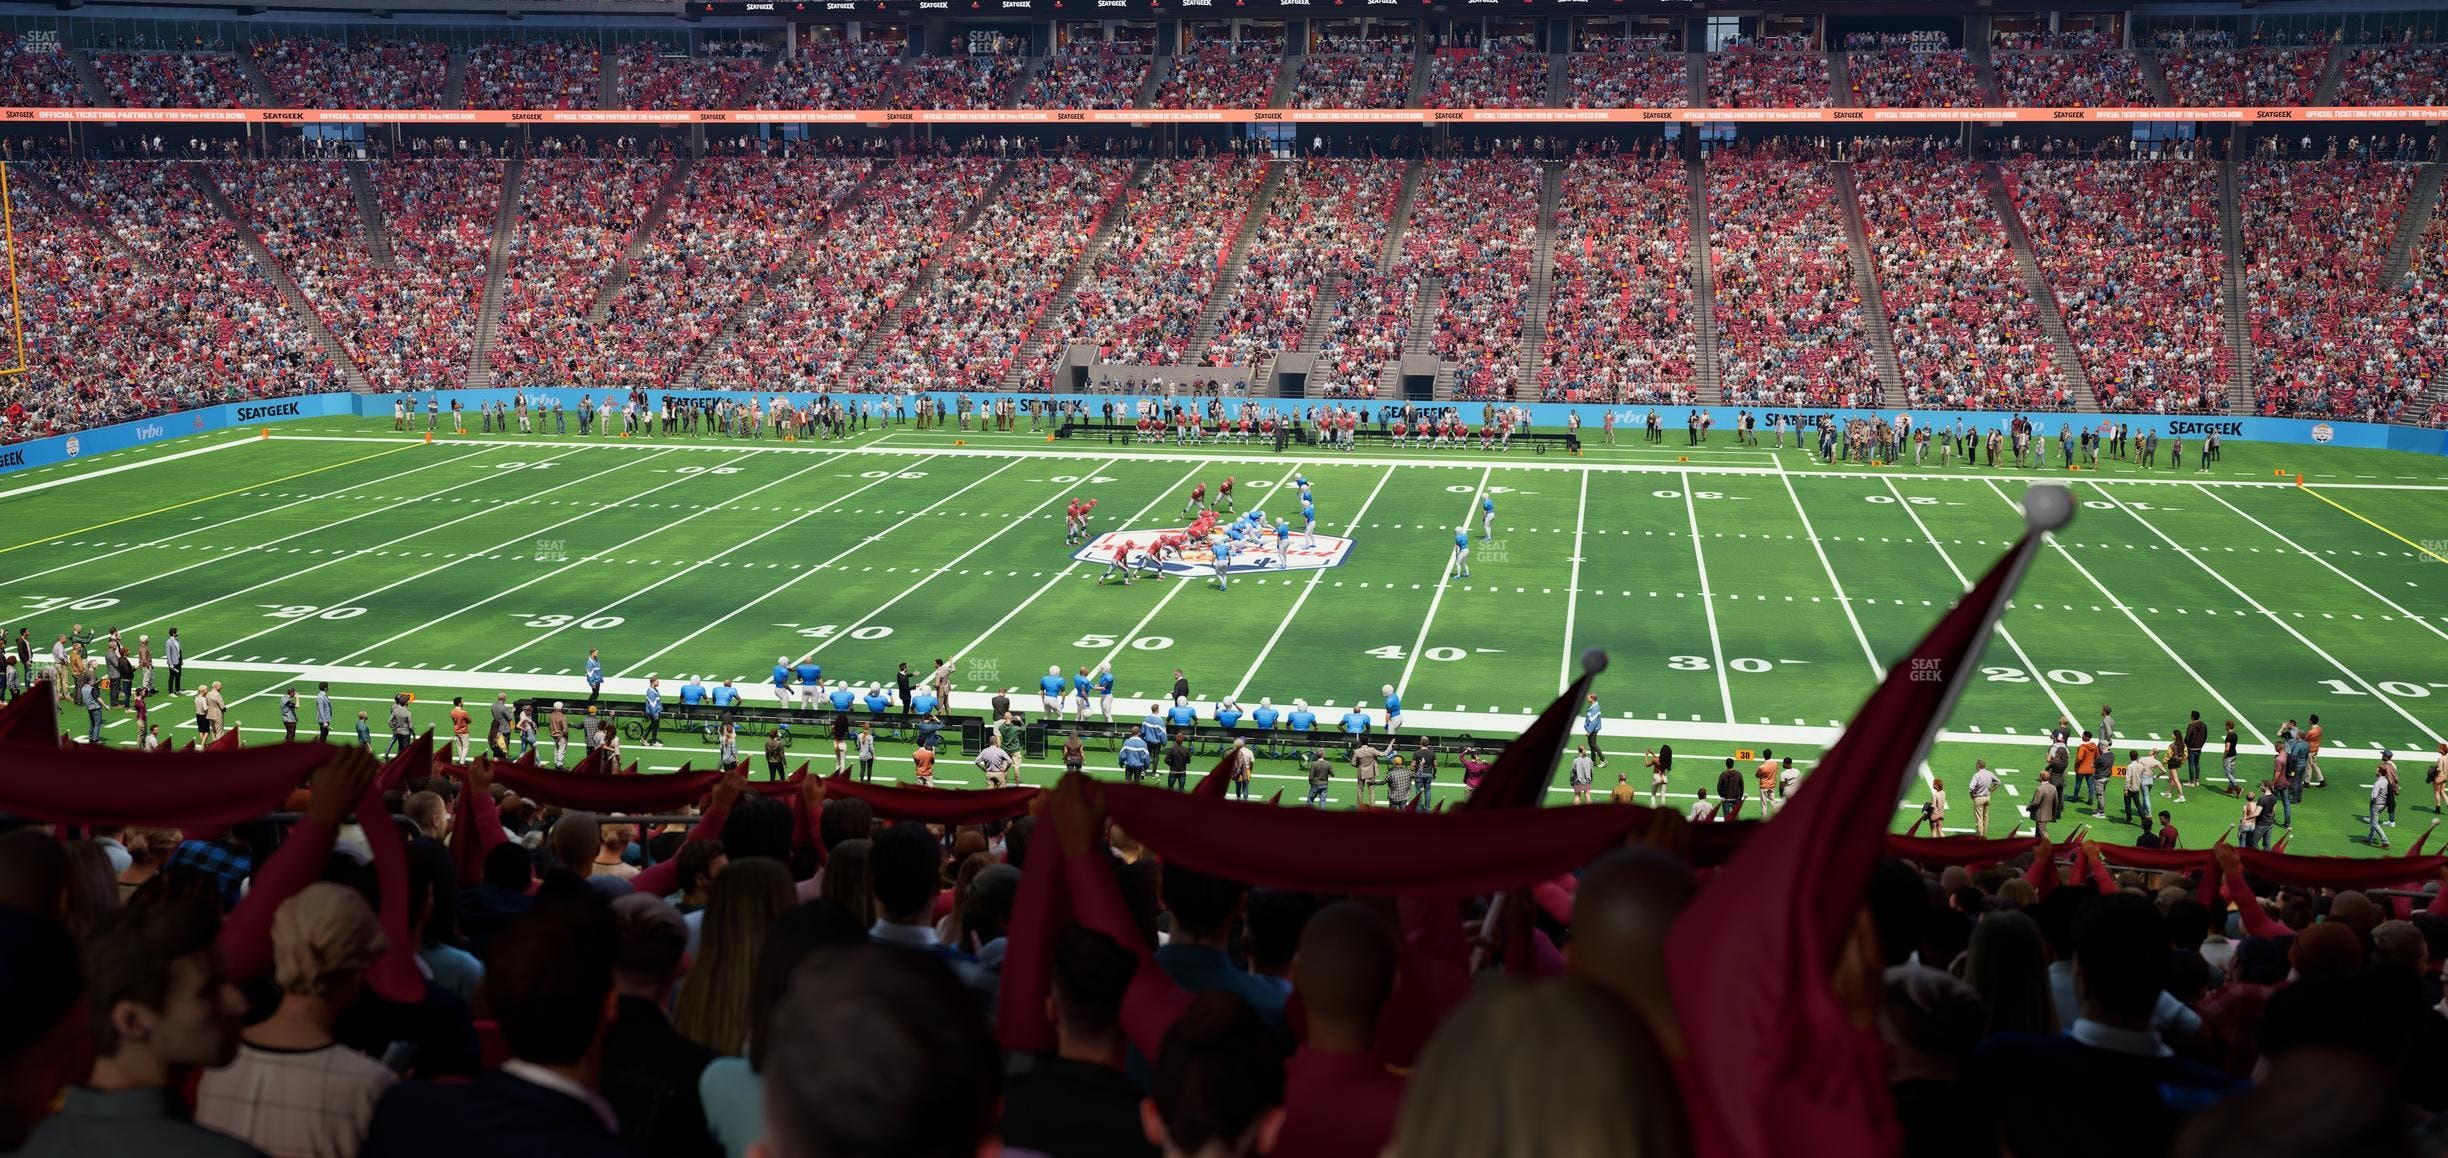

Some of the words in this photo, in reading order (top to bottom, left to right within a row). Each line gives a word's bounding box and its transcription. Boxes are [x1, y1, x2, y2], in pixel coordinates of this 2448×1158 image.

[237, 402, 300, 422] SEATGEEK
[136, 424, 164, 440] Vrbo
[2169, 421, 2242, 436] SEATGEEK
[21, 596, 120, 610] 10
[262, 606, 367, 619] 20
[524, 614, 625, 630] 30
[796, 624, 894, 640] 40
[1073, 634, 1174, 650] 50
[1365, 646, 1467, 661] 40
[1668, 656, 1773, 672] 30
[1981, 667, 2094, 684] 20
[2318, 680, 2431, 698] 10
